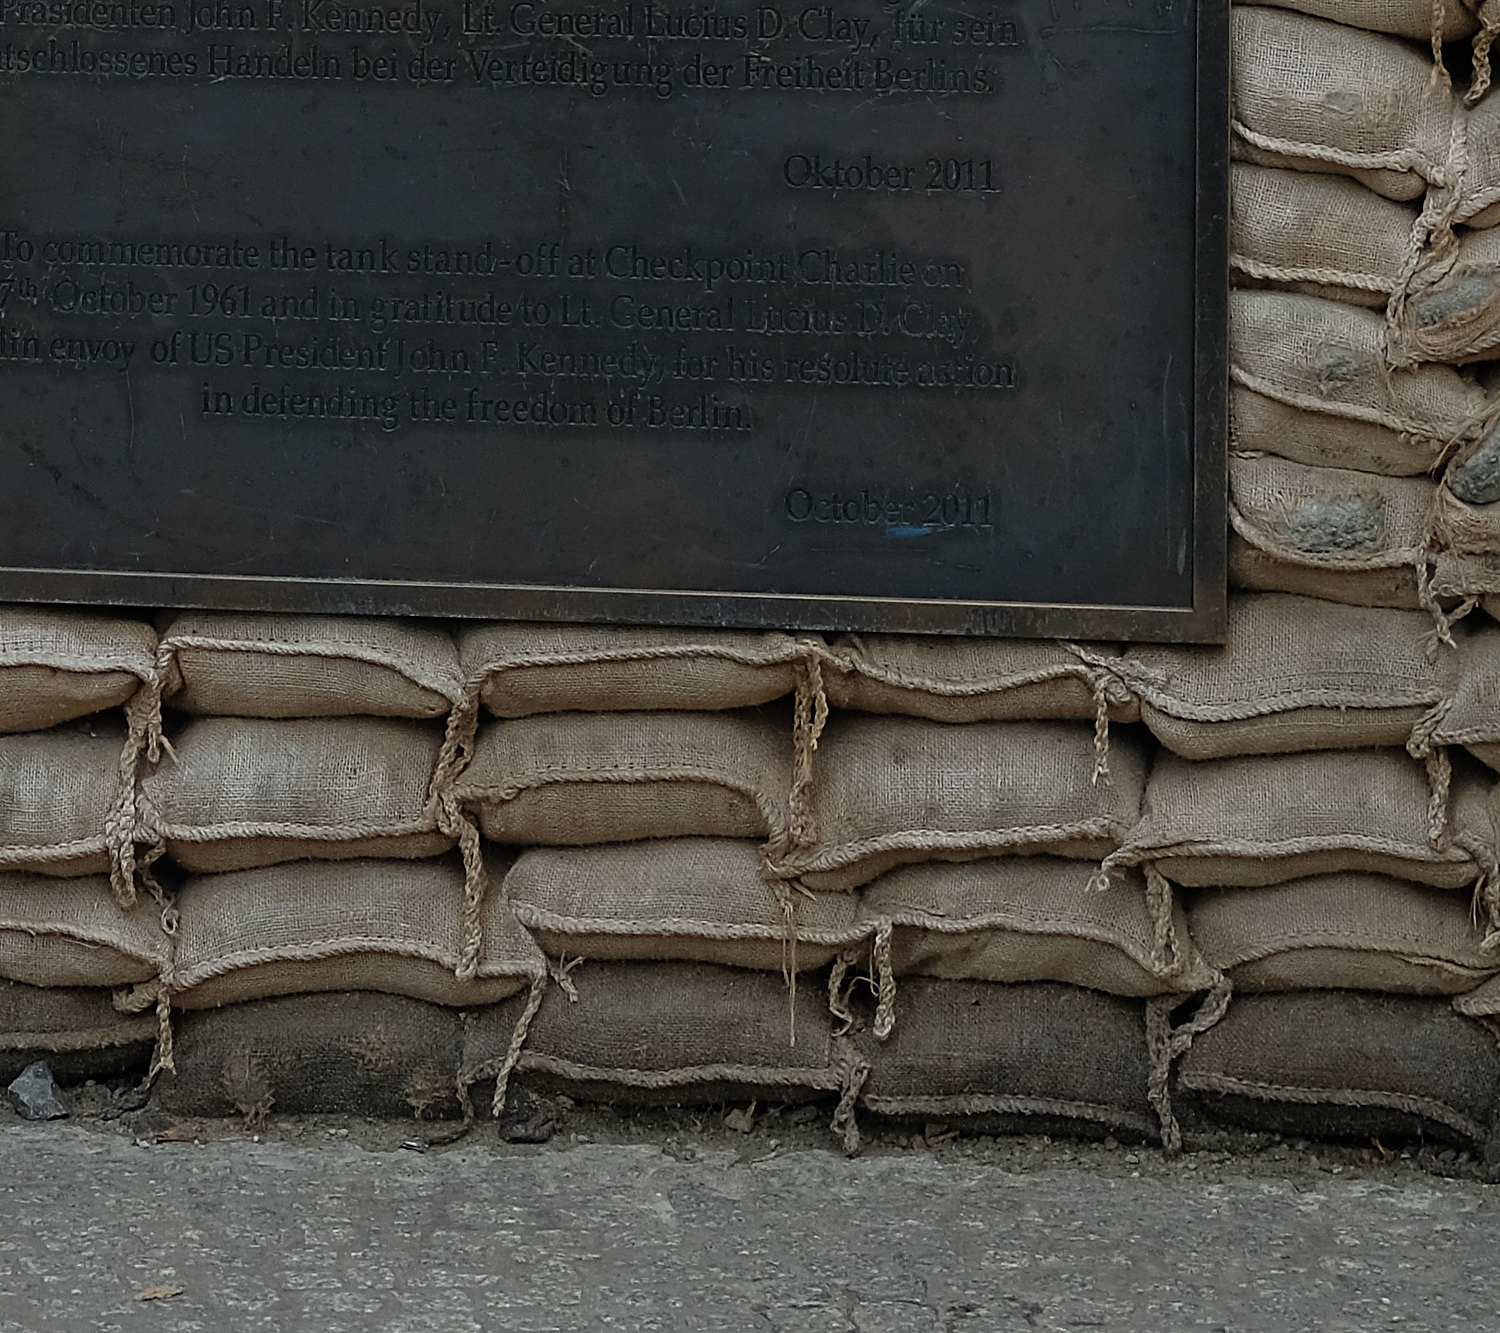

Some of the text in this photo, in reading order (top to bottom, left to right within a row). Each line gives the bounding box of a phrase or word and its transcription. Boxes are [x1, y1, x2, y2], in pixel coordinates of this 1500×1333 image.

[462, 0, 497, 34] Lt.
[509, 0, 634, 38] General
[647, 3, 748, 41] Lucius
[757, 7, 789, 42] D.
[799, 5, 880, 52] Clay,
[893, 9, 944, 45] für
[951, 11, 1019, 47] sein
[207, 42, 342, 81] Handeln
[351, 43, 398, 80] bei
[406, 45, 457, 82] der
[464, 47, 674, 97] Verteidigung
[683, 53, 733, 88] der
[744, 54, 866, 92] Freiheit
[873, 56, 997, 95] Berlins.
[782, 153, 1003, 194] Oktober 2011
[0, 230, 34, 265] To
[42, 240, 260, 270] commemorate
[268, 236, 317, 271] the
[324, 236, 399, 275] tank
[567, 249, 599, 278] at
[604, 244, 789, 291] Checkpoint
[799, 249, 916, 288] Charlie
[922, 259, 965, 288] on
[50, 280, 178, 316] October
[185, 283, 252, 318] 1961
[260, 285, 319, 323] and
[328, 287, 360, 323] in
[368, 289, 512, 329] gratitude
[522, 298, 551, 327] to
[558, 292, 601, 328] Lt.
[609, 294, 734, 331] General
[746, 297, 848, 334] Lucius
[856, 301, 891, 336] D.
[50, 338, 136, 372] envoy
[151, 331, 185, 364] of
[189, 333, 236, 366] US
[241, 334, 391, 371] President
[396, 339, 470, 378] John
[479, 340, 507, 373] F.
[517, 341, 661, 387] Kennedy,
[673, 345, 718, 382] for
[726, 346, 773, 383] his
[782, 348, 909, 386] resolute
[916, 353, 1017, 389] action
[200, 382, 751, 433] in defending the freedom of Berlin.
[783, 488, 994, 529] October 2011
